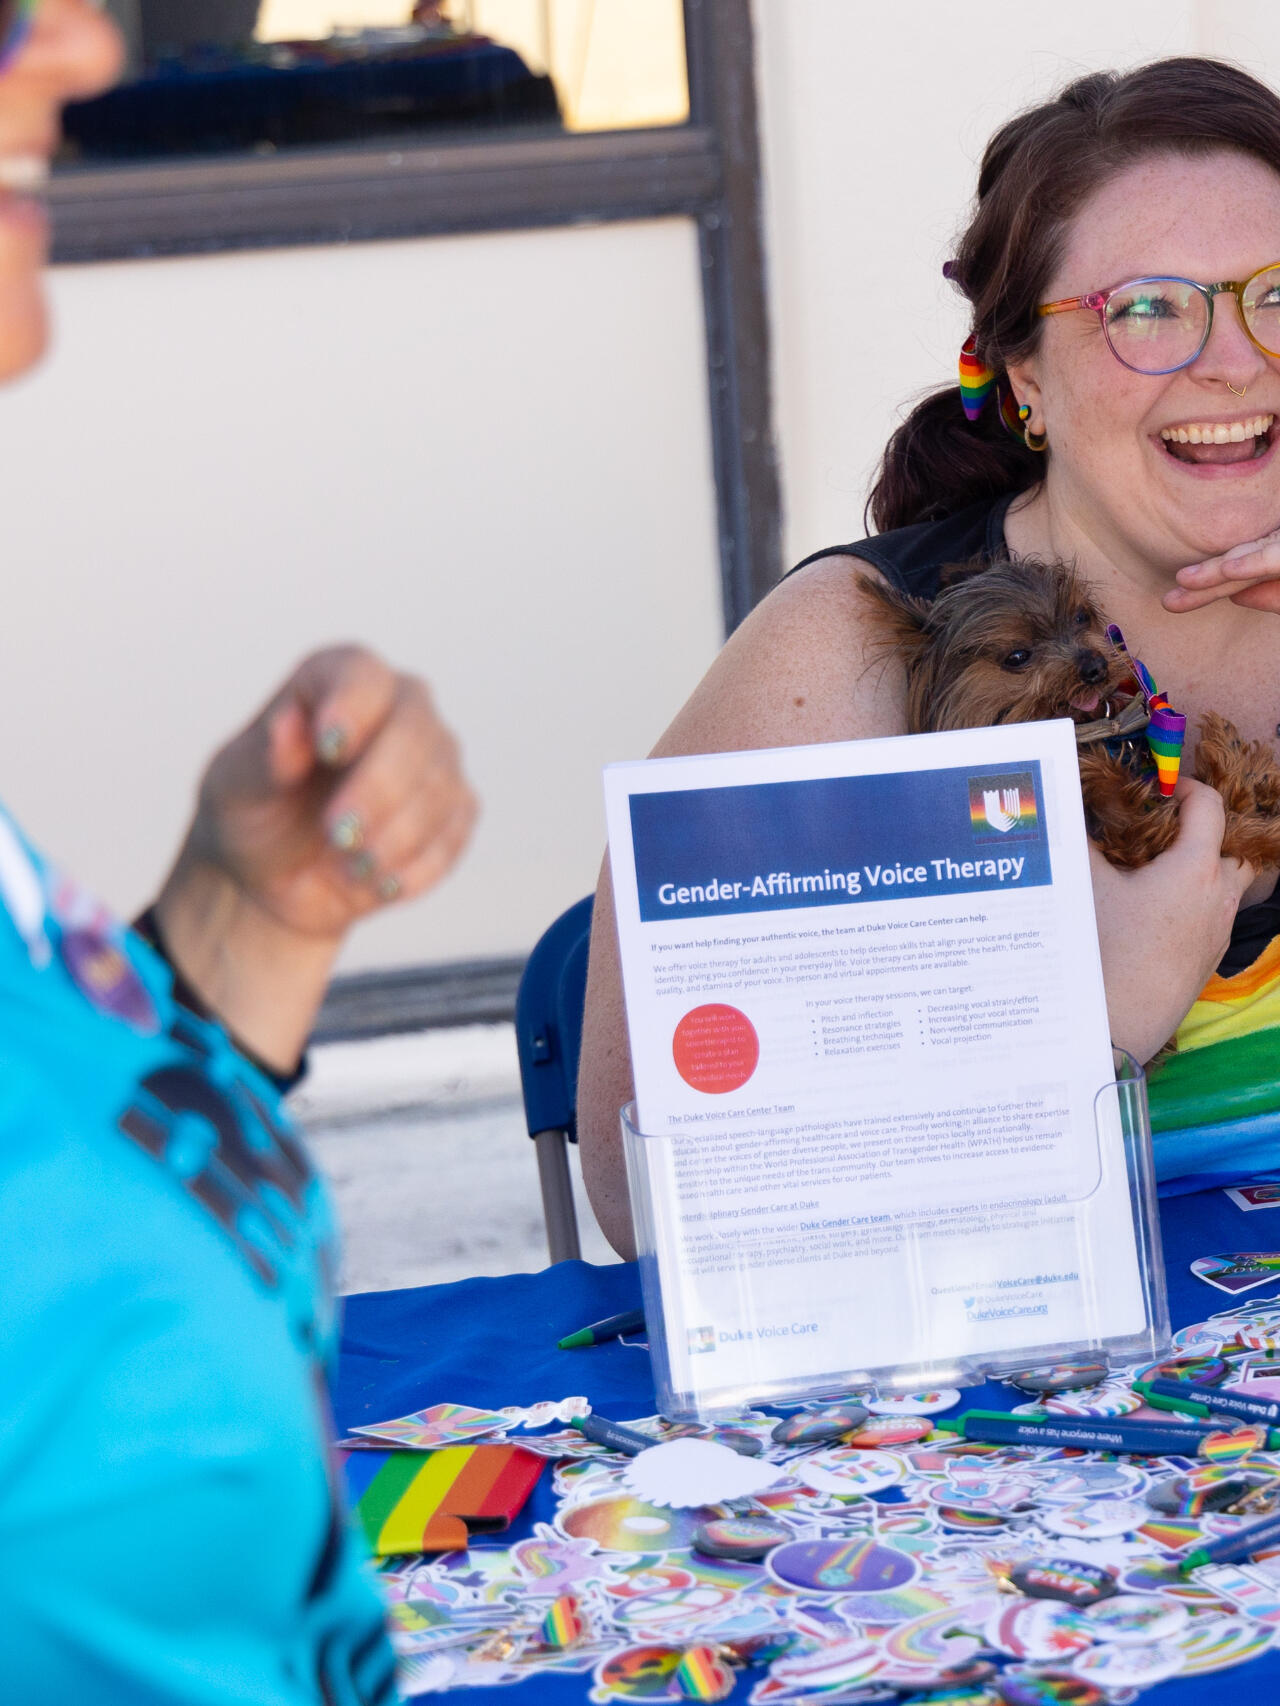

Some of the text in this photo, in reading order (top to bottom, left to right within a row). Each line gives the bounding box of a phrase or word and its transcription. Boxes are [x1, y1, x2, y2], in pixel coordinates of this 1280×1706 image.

[658, 856, 1025, 905] Gender-Affirming Voice Therapy
[658, 944, 673, 952] you
[674, 940, 693, 949] want
[694, 939, 712, 948] help
[713, 937, 740, 946] finding
[741, 936, 759, 945] your
[760, 931, 796, 941] authentic
[798, 930, 820, 938] voice,
[821, 928, 834, 936] the
[866, 923, 886, 931] Duke
[887, 922, 908, 930] Voice
[909, 920, 926, 928] Care
[927, 917, 953, 926] Center
[969, 914, 988, 923] help.
[668, 963, 686, 972] offer
[687, 961, 708, 970] voice
[709, 959, 739, 968] therapy
[739, 957, 751, 965] for
[753, 955, 776, 964] adults
[778, 953, 792, 961] and
[794, 949, 839, 960] adolescents
[849, 946, 866, 955] help
[868, 944, 897, 953] develop
[899, 942, 917, 950] skills
[919, 940, 935, 948] that
[937, 938, 956, 948] align
[957, 938, 974, 947] your
[976, 935, 996, 943] voice
[997, 932, 1012, 941] and
[1013, 930, 1040, 941] gender
[687, 972, 711, 983] giving
[712, 972, 726, 980] you
[727, 968, 770, 977] confidence
[780, 965, 797, 974] your
[798, 961, 832, 971] everyday
[850, 957, 870, 966] Voice
[872, 955, 901, 964] therapy
[918, 951, 933, 959] also
[934, 949, 966, 959] improve
[967, 947, 981, 955] the
[685, 984, 700, 992] and
[702, 981, 733, 990] stamina
[743, 980, 761, 989] your
[823, 971, 838, 979] and
[839, 968, 864, 978] virtual
[865, 964, 918, 977] appointments
[814, 999, 832, 1008] your
[833, 996, 853, 1005] voice
[854, 994, 884, 1003] therapy
[886, 991, 919, 1000] sessions,
[927, 995, 1038, 1012] Decreasing vocal strain/effort
[821, 1010, 893, 1023] Pitch and inflection
[928, 1007, 1039, 1023] Increasing your vocal stamina
[822, 1020, 901, 1034] Resonance strategies
[929, 1018, 1032, 1034] Non-verbal communication
[823, 1032, 903, 1045] Breathing techniques
[931, 1033, 991, 1045] Vocal projection
[824, 1043, 900, 1056] Relaxation exercises
[668, 1115, 682, 1123] The
[683, 1113, 704, 1122] Duke
[705, 1111, 726, 1119] Voice
[746, 1106, 772, 1115] Center
[718, 1322, 818, 1342] Duke Voice Care
[1018, 1425, 1039, 1436] voice
[1061, 1428, 1095, 1440] everyone
[1097, 1431, 1123, 1444] Where
